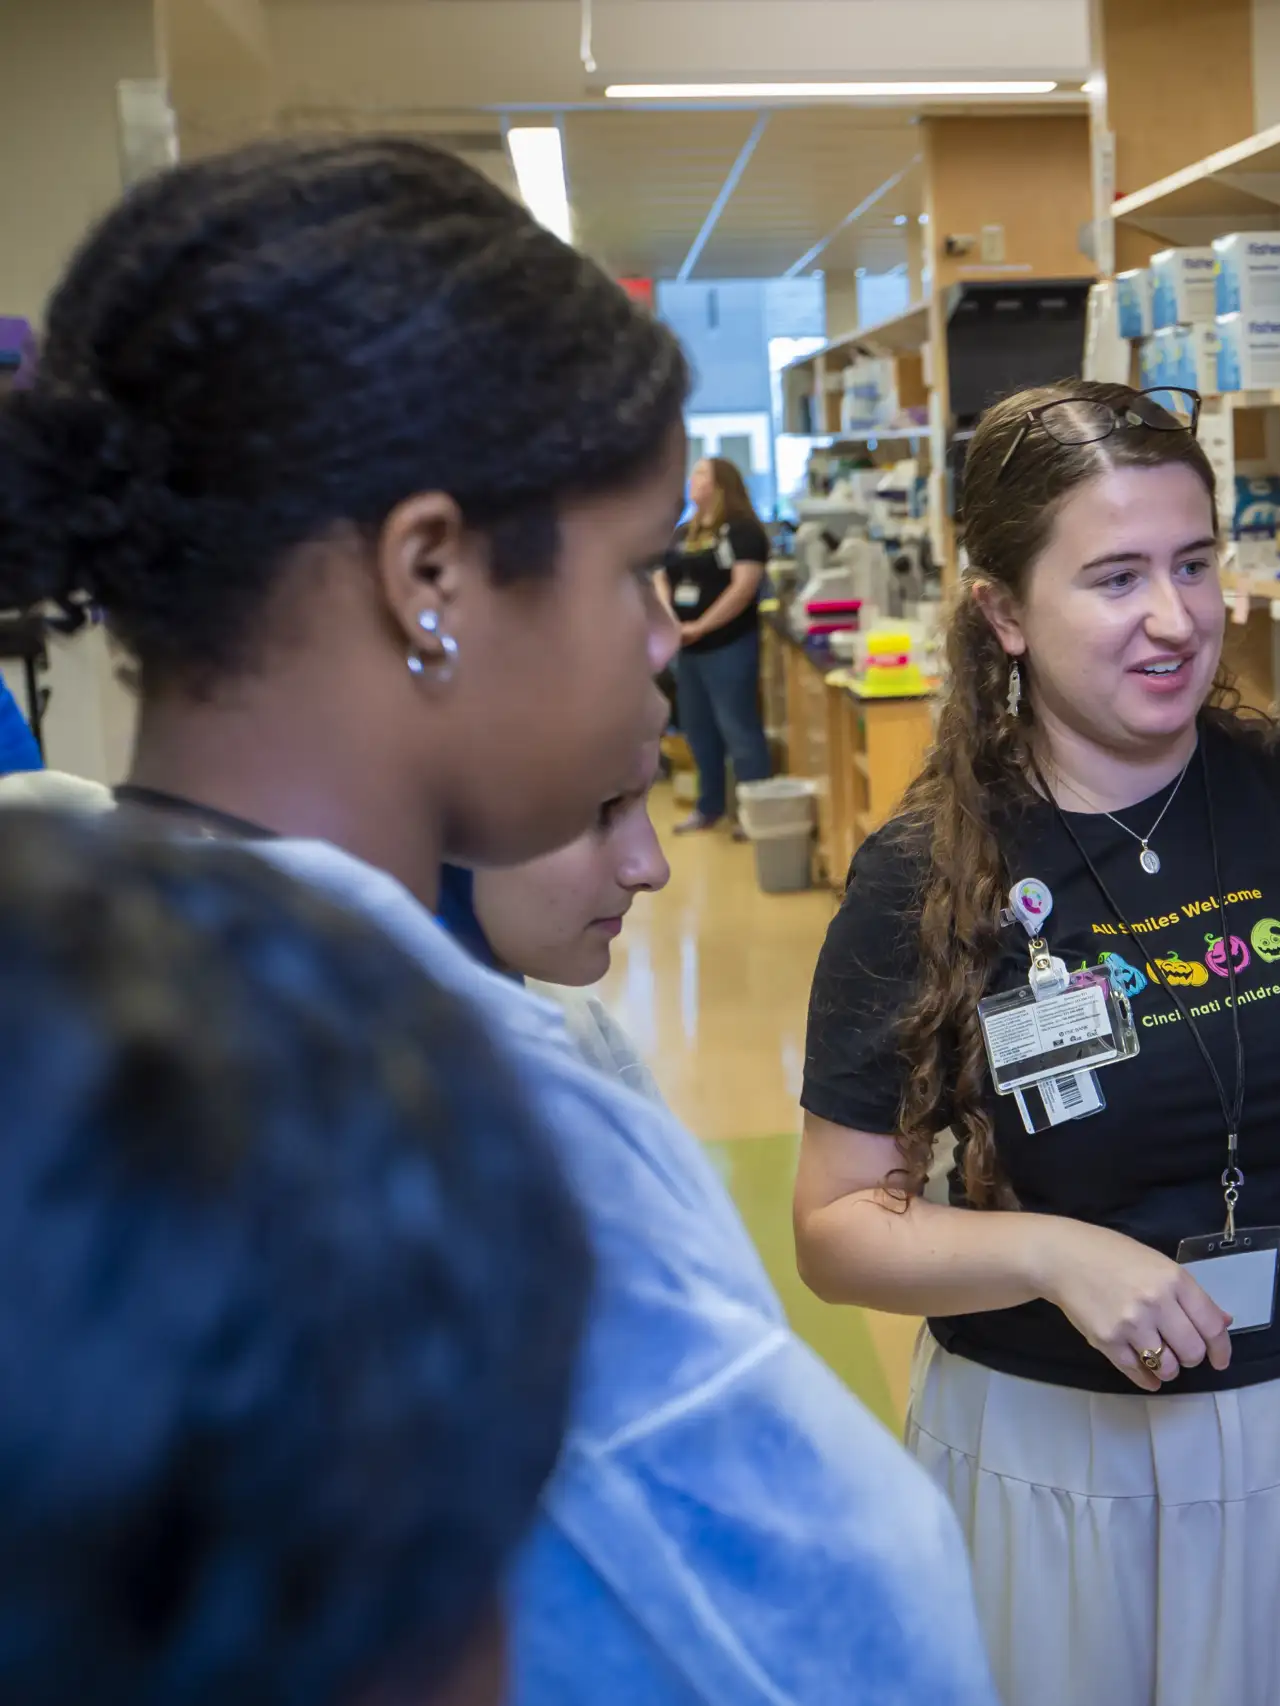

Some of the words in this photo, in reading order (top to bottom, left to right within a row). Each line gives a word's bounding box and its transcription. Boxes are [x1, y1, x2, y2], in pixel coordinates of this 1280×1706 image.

[1091, 923, 1117, 935] All
[1118, 911, 1180, 935] Smiles
[1142, 1000, 1221, 1027] Cincinati
